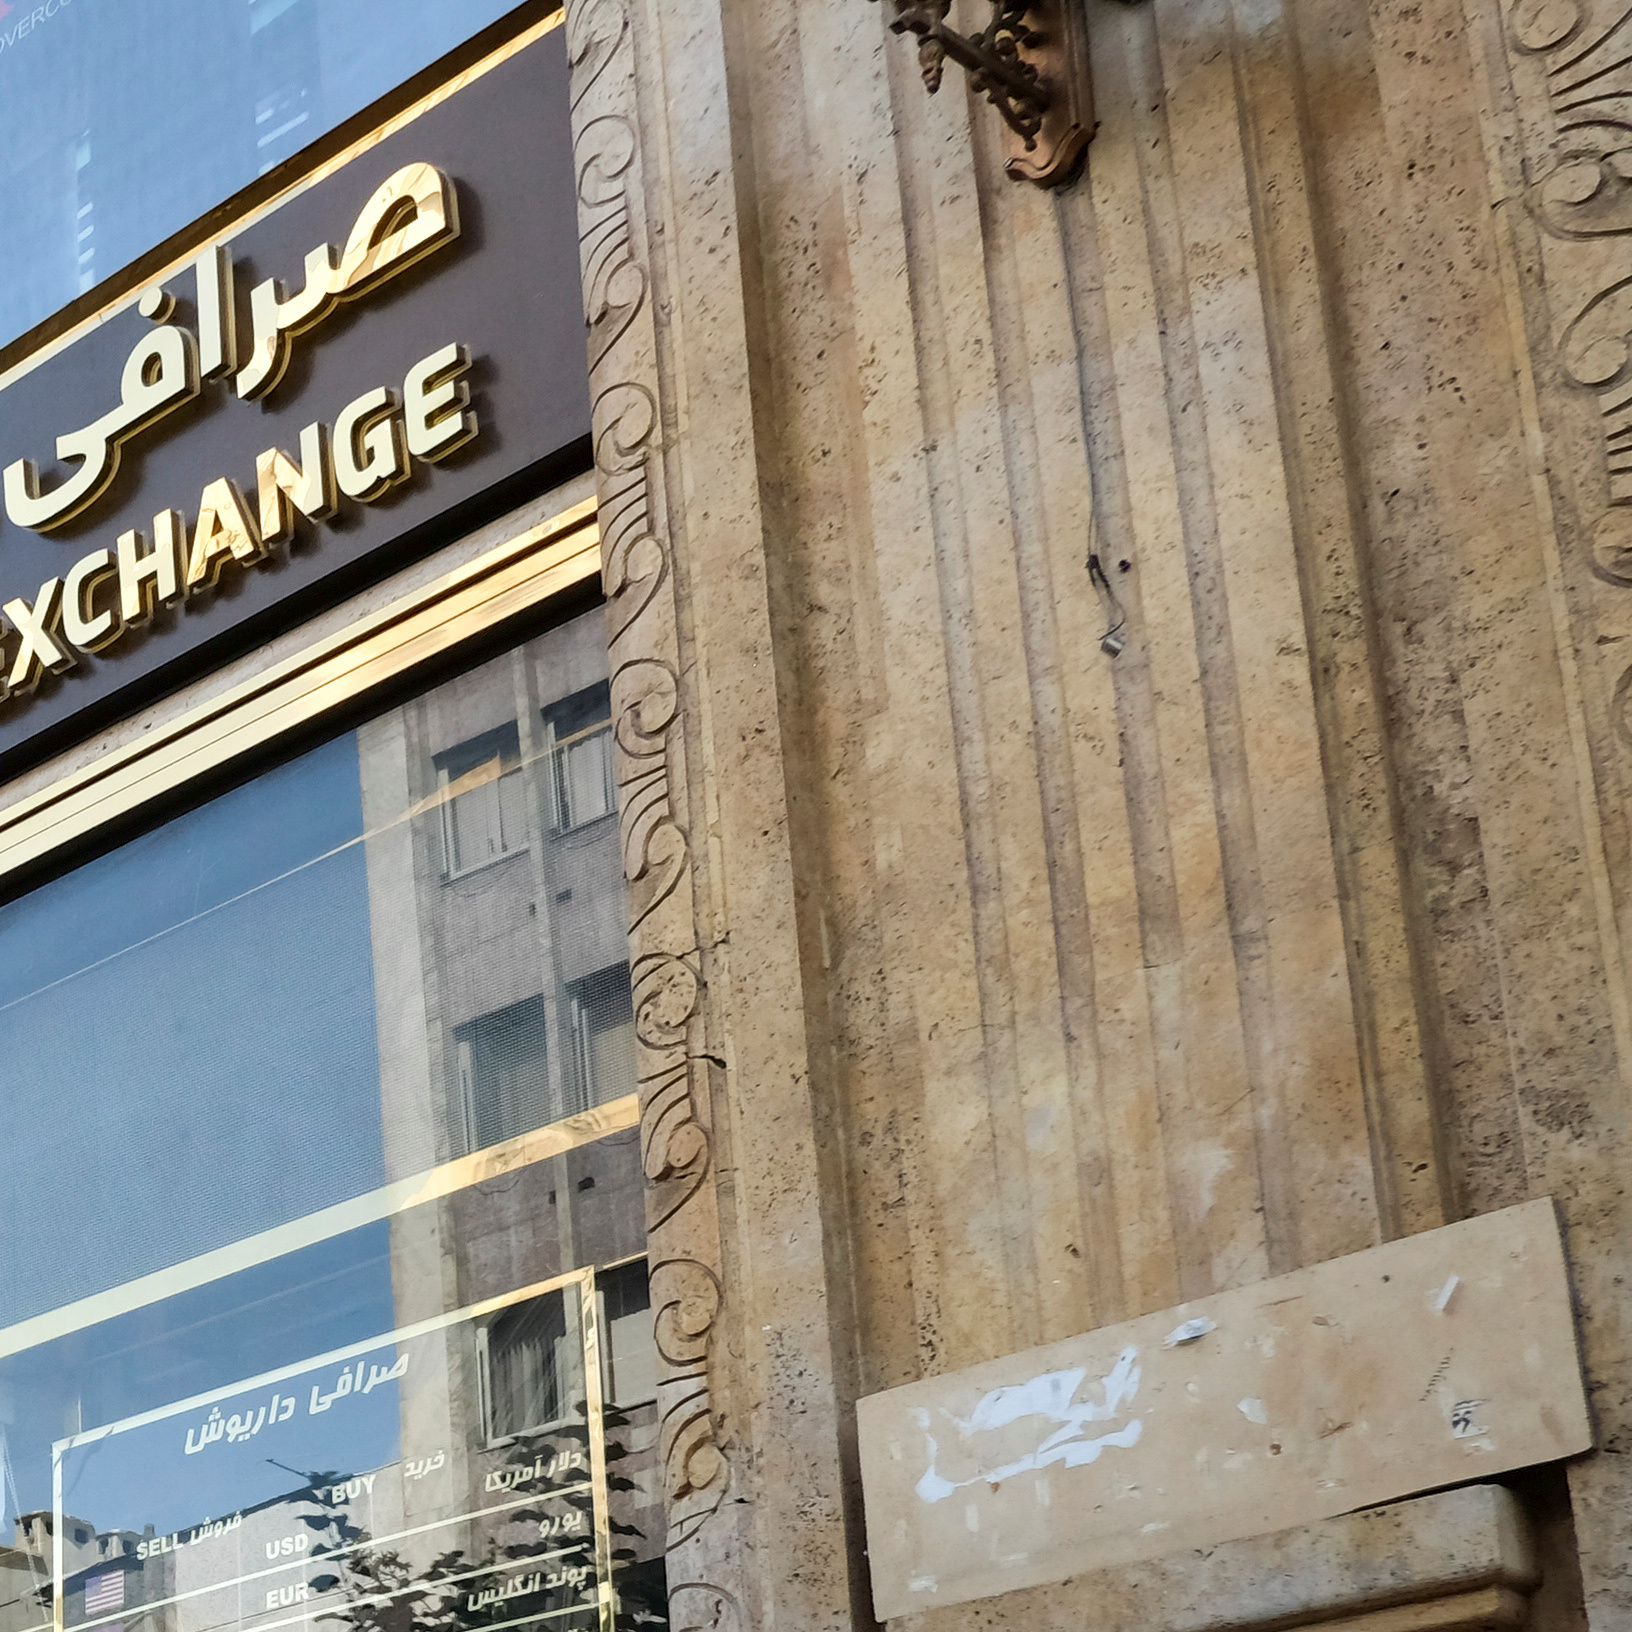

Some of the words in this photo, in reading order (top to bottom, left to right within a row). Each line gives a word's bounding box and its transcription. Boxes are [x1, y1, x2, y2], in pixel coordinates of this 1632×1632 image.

[4, 160, 458, 532] صرافی
[309, 1353, 409, 1415] صرافی
[184, 1394, 296, 1455] داریوش
[404, 1450, 445, 1480] خرید
[486, 1454, 542, 1493] آمریکا
[546, 1450, 582, 1479] دلار
[331, 1474, 377, 1504] BUY
[190, 1511, 243, 1546] فروش
[538, 1511, 583, 1538] یورو
[136, 1532, 184, 1561] SELL
[265, 1533, 308, 1560] USD
[467, 1572, 540, 1612] انگلیس
[545, 1565, 587, 1590] پوند
[266, 1582, 309, 1610] EUR
